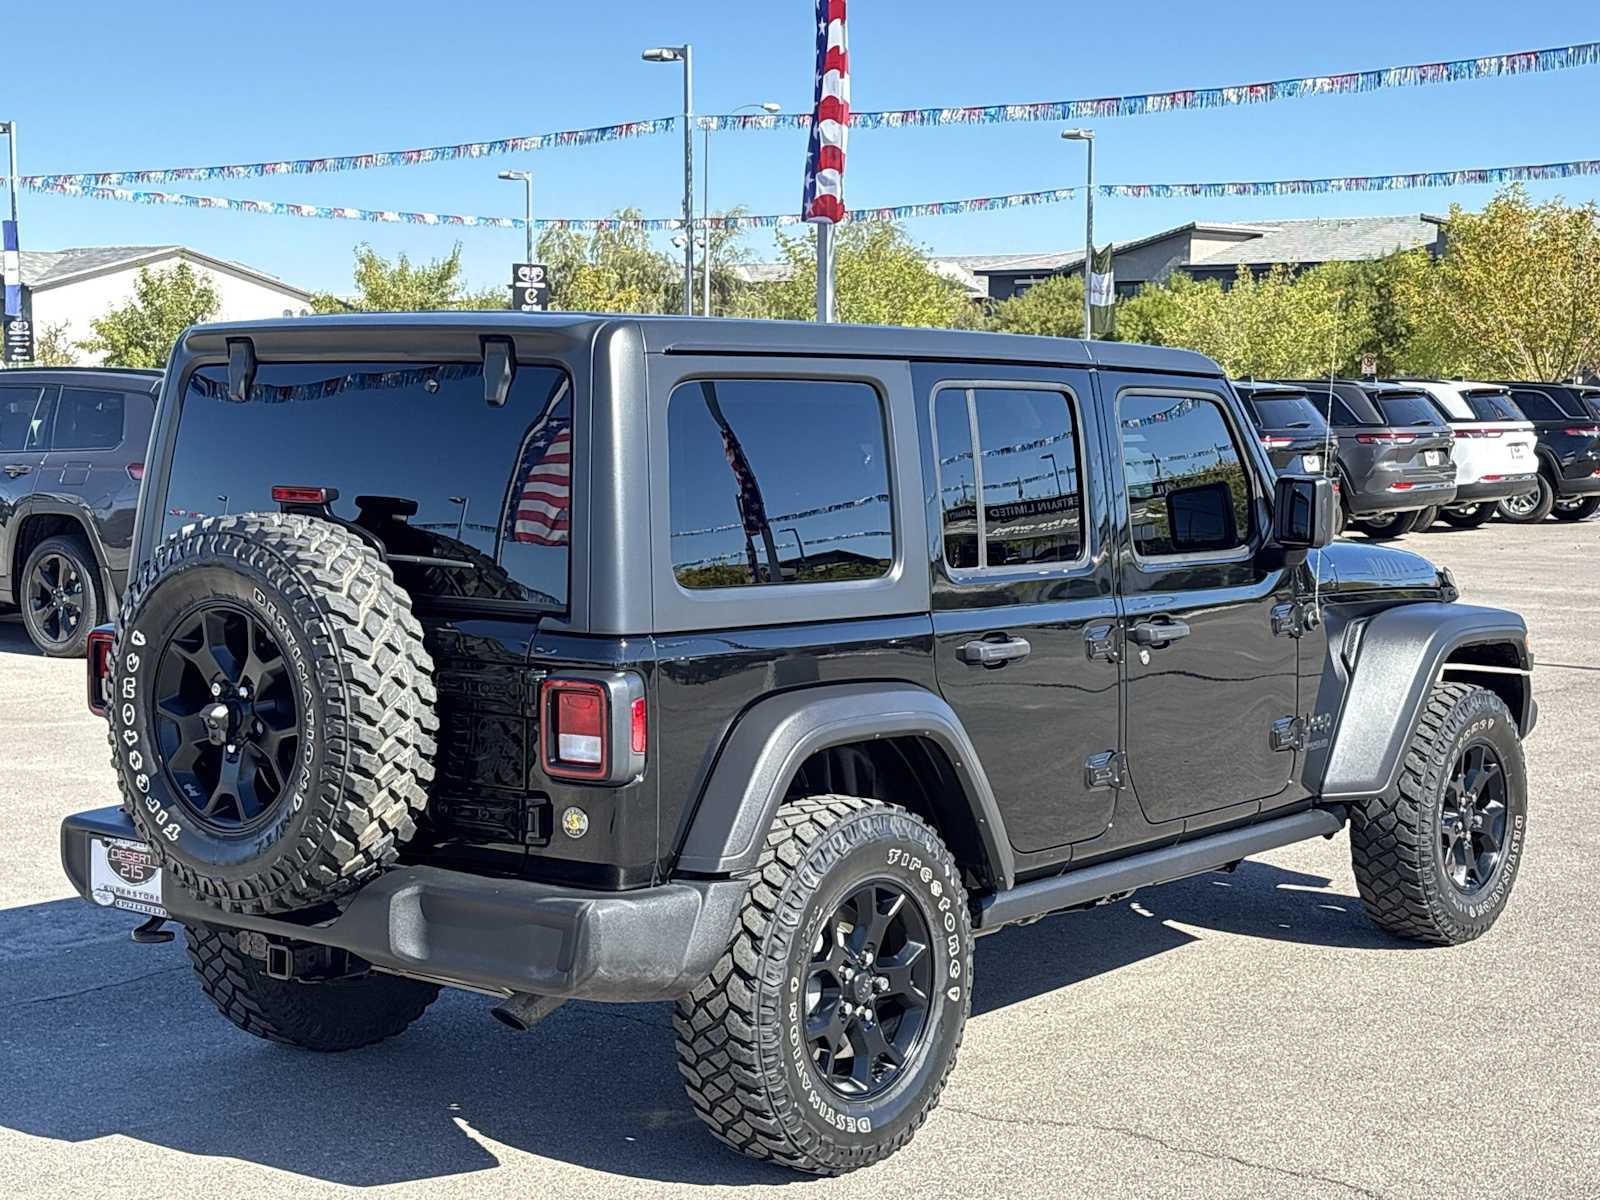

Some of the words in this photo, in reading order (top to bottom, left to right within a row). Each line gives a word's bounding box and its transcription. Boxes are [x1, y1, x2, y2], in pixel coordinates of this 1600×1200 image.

[122, 652, 182, 841] Firestone
[254, 587, 314, 790] DESTINATION
[111, 848, 152, 864] DESERT
[121, 863, 144, 879] 215
[888, 848, 961, 979] Firestone
[1475, 815, 1524, 917] DESTINATION
[789, 1002, 872, 1134] DESTINATION
